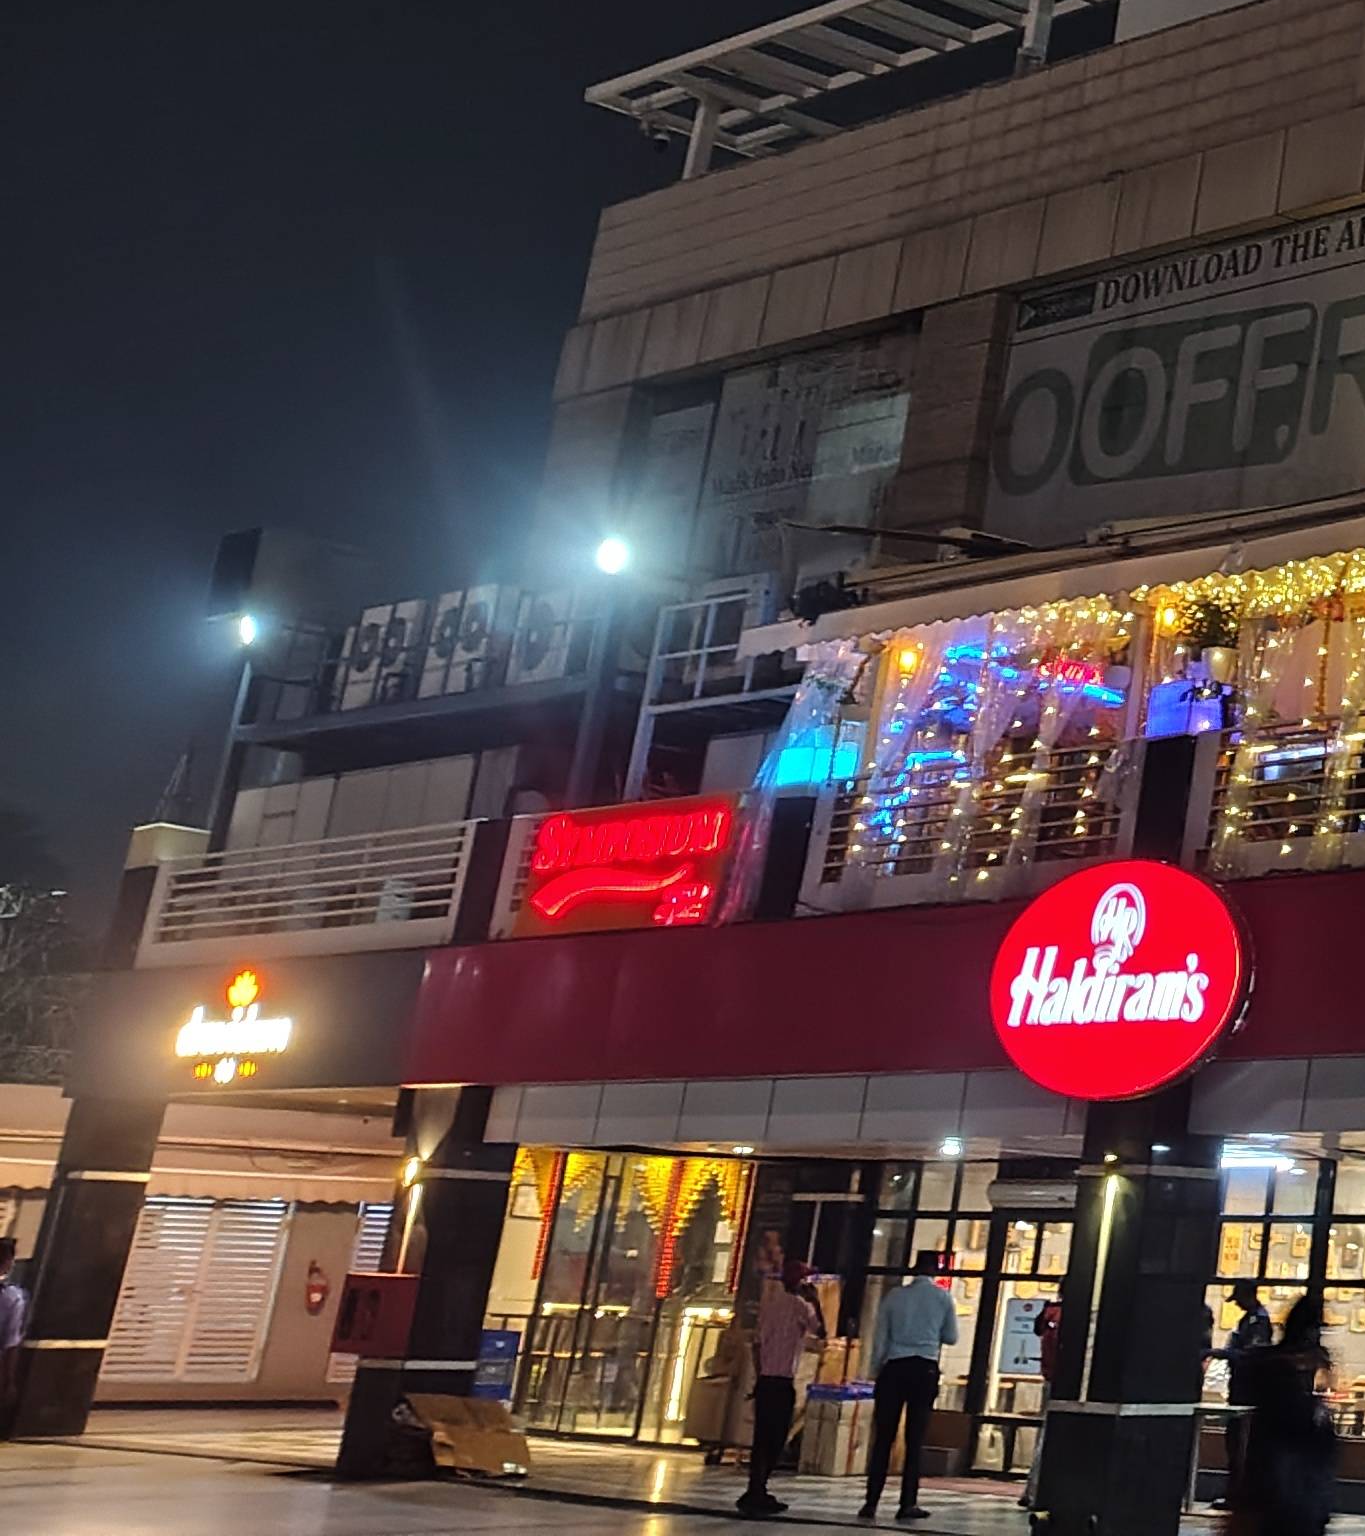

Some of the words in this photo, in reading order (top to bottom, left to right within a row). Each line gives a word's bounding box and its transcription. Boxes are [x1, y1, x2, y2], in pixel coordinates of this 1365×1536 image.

[1101, 242, 1262, 311] DOWNLOAD
[1271, 223, 1330, 270] THE
[1007, 944, 1210, 1028] Haldiram's
